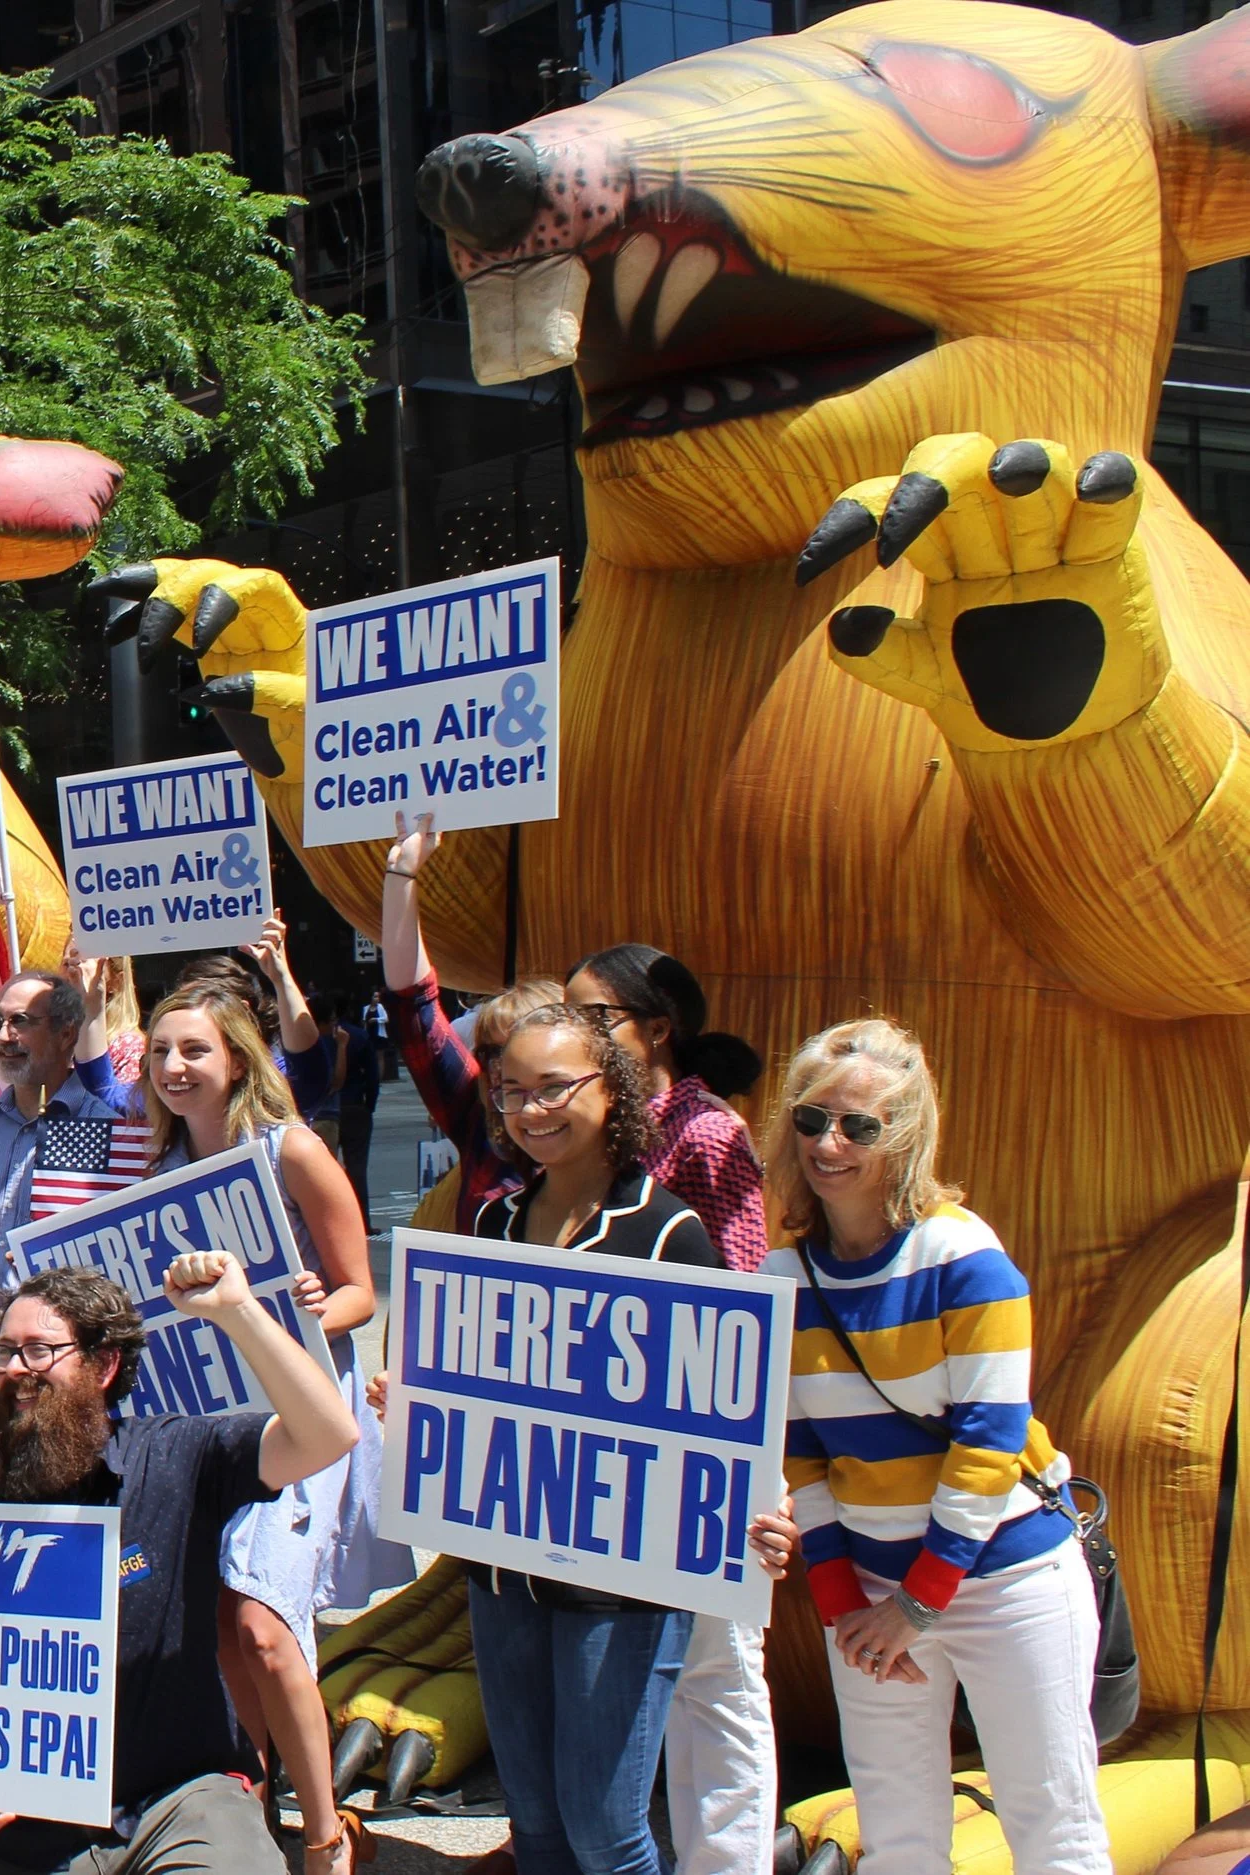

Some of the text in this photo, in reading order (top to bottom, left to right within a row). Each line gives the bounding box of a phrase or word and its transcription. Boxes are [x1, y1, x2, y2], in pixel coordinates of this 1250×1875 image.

[317, 583, 543, 692] WE WANT
[315, 717, 420, 762] Clean
[67, 767, 249, 841] WE WANT
[314, 745, 546, 811] Clean Water!
[75, 861, 160, 894] Clean
[79, 888, 262, 932] Clean Water!
[195, 1178, 274, 1269] NO
[412, 1267, 648, 1404] THERE'S
[665, 1302, 761, 1422] NO
[402, 1401, 751, 1584] PLANET B!
[0, 1625, 99, 1695] Public
[20, 1709, 98, 1781] EPA!
